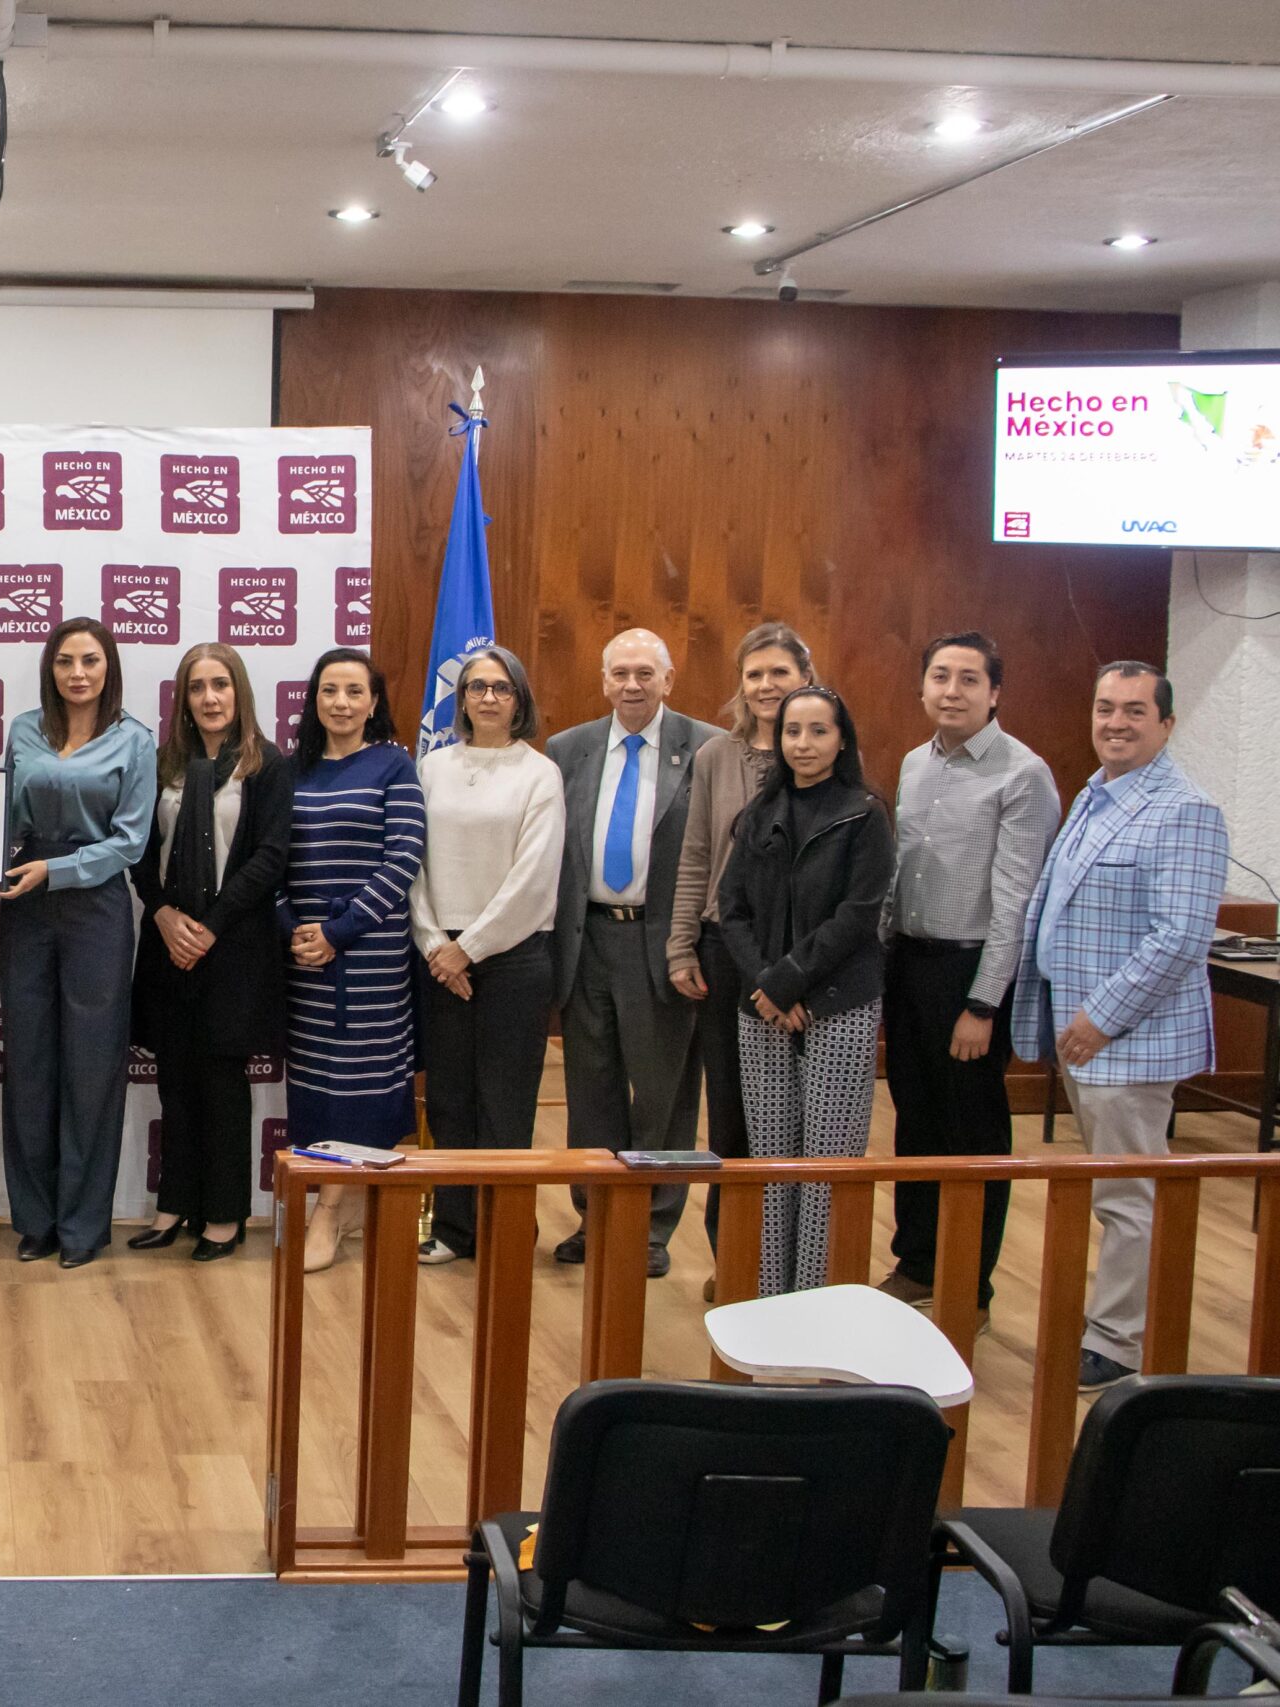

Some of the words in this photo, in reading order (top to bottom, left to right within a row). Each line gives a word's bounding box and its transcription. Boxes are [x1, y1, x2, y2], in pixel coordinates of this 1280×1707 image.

[1007, 390, 1103, 412] Hecho
[1111, 395, 1148, 412] en
[1007, 413, 1114, 437] México
[54, 461, 92, 471] HECHO
[96, 461, 111, 471] EN
[172, 465, 210, 475] HECHO
[213, 466, 228, 475] EN
[289, 465, 327, 475] HECHO
[330, 465, 345, 474] EN
[55, 506, 111, 521] MÉXICO
[172, 510, 229, 525] MÉXICO
[289, 509, 345, 525] MÉXICO
[37, 574, 52, 583] EN
[113, 575, 151, 585] HECHO
[154, 576, 169, 585] EN
[230, 577, 268, 587] HECHO
[271, 577, 286, 587] EN
[346, 577, 371, 587] HEC
[112, 619, 169, 635] MÉXICO
[230, 622, 285, 637] MÉXICO
